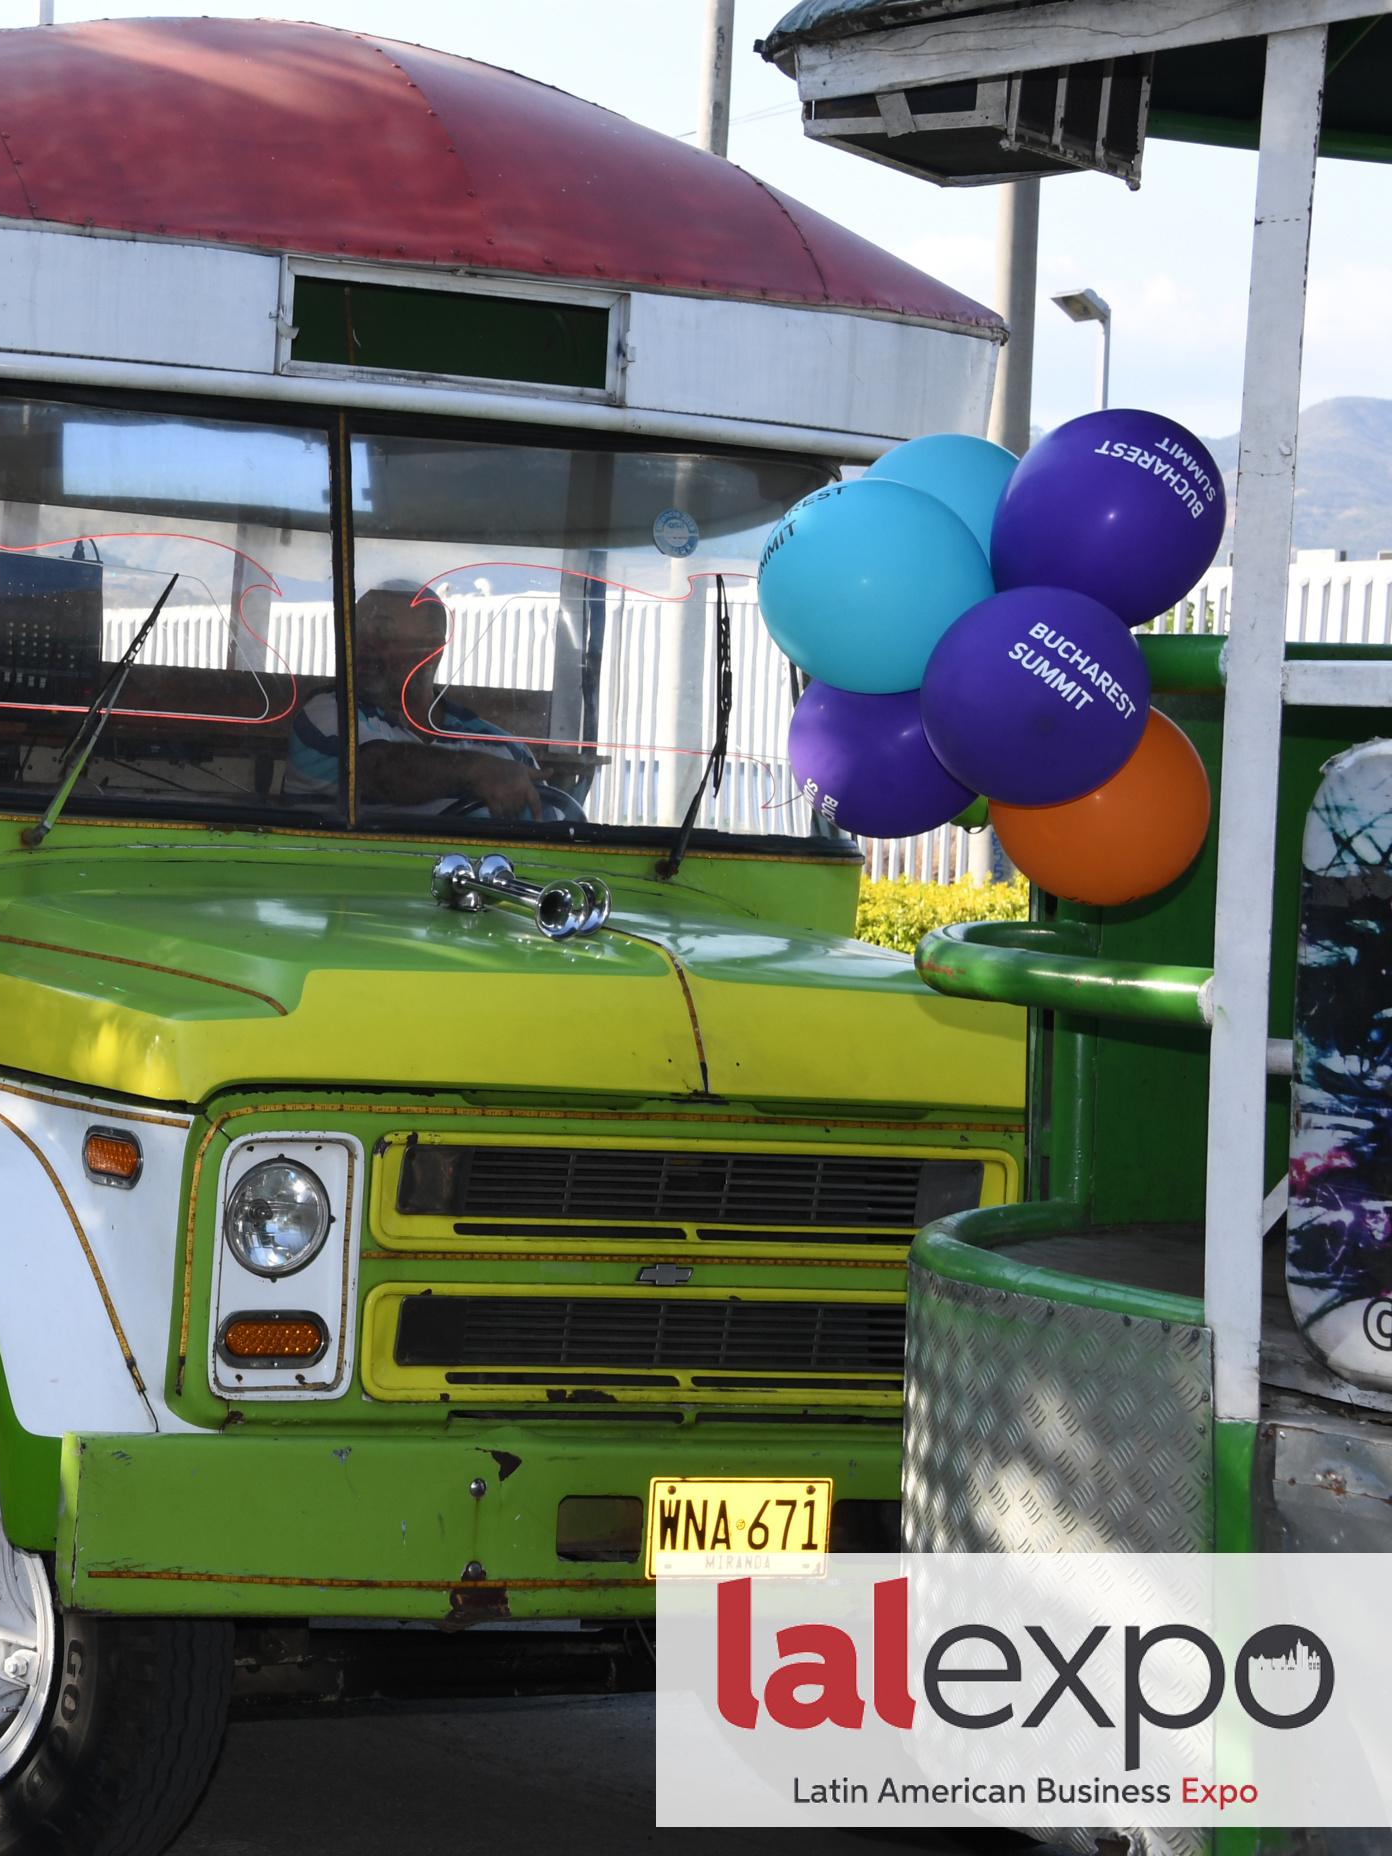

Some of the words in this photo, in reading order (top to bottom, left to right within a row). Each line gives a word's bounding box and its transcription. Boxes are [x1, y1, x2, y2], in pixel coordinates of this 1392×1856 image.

[1094, 440, 1205, 519] BUCHAREST
[1154, 437, 1216, 502] SUMMIT
[1008, 642, 1094, 711] SUMMIT
[1028, 621, 1136, 720] BUCHAREST
[659, 1499, 731, 1551] WNA
[747, 1499, 818, 1551] 671
[705, 1554, 771, 1570] MIRANDA
